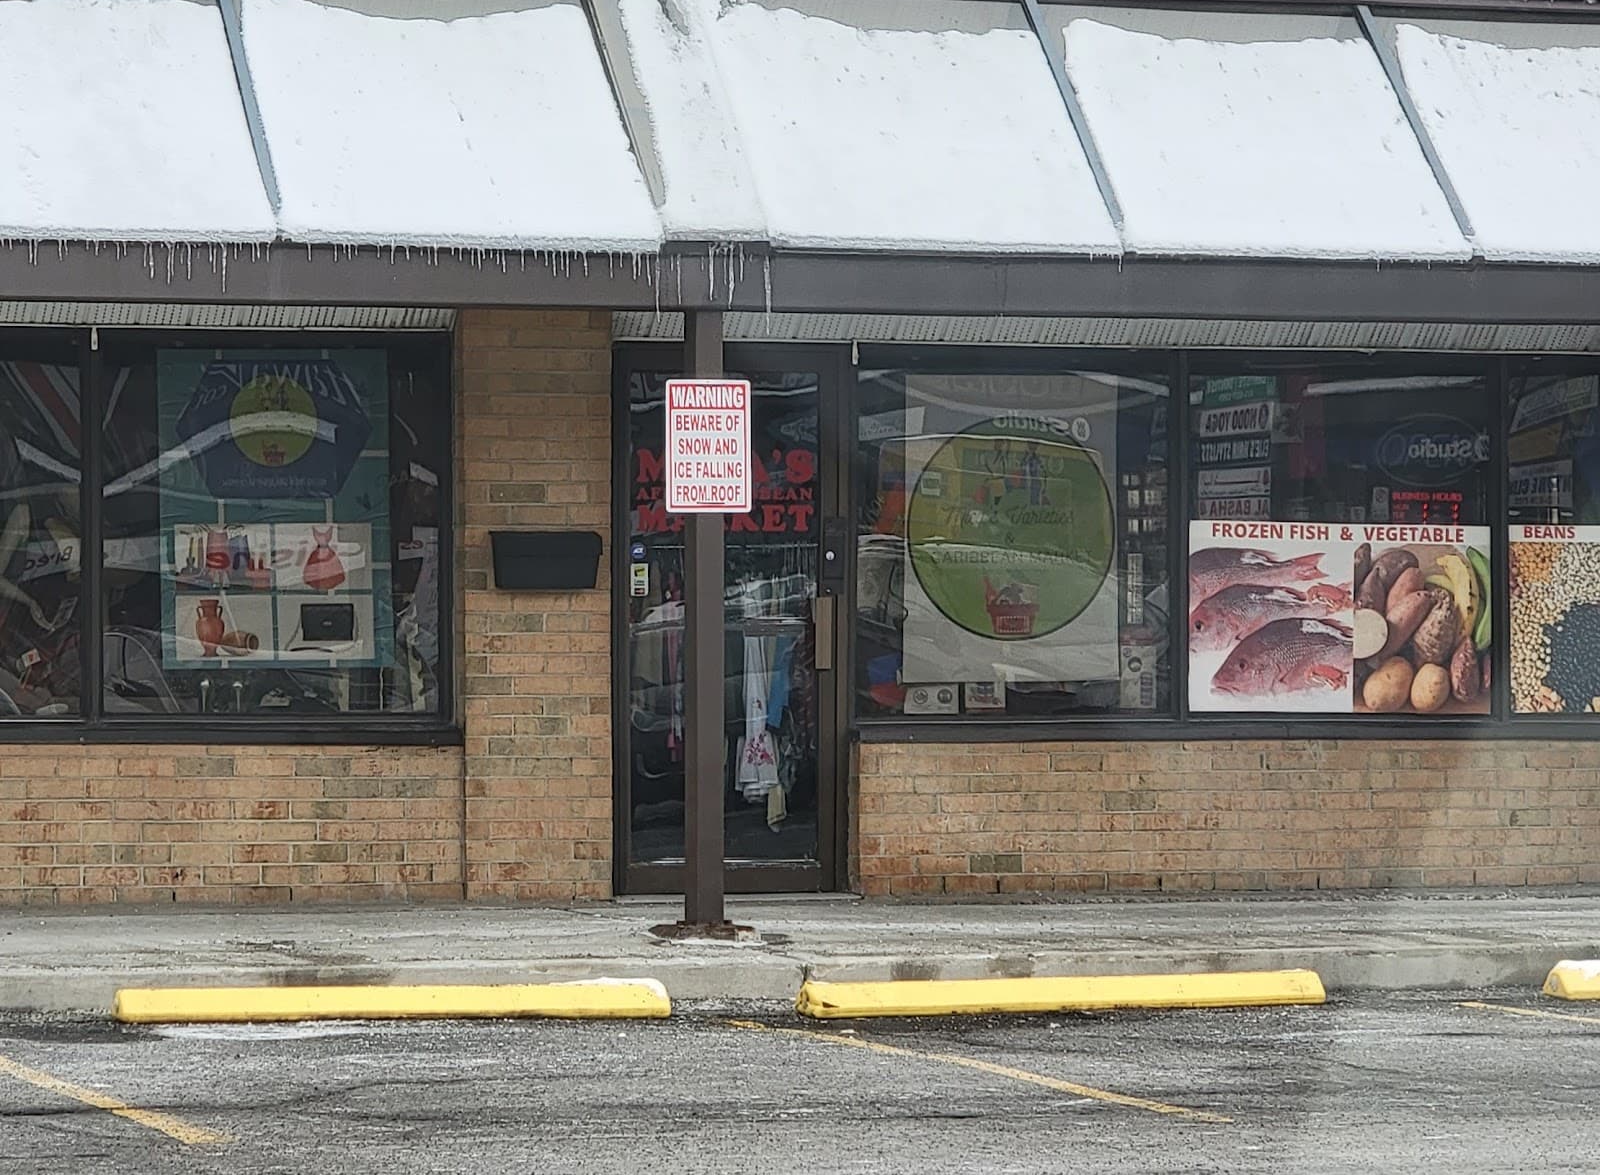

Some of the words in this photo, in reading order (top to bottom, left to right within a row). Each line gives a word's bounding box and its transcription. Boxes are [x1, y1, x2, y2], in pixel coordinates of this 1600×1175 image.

[672, 386, 744, 409] WARNING
[675, 415, 721, 431] BEWARE
[726, 415, 740, 431] OF
[678, 438, 711, 455] SNOW
[714, 438, 738, 454] AND
[674, 463, 692, 479] ICE
[696, 462, 743, 478] FALLING
[675, 485, 707, 501] FROM
[710, 485, 741, 501] ROOF
[637, 505, 814, 532] MKET
[1212, 523, 1284, 540] FROZEN
[1289, 525, 1330, 541] FISH
[1340, 526, 1354, 541] &
[1363, 526, 1466, 543] VEGETABLE
[1523, 526, 1577, 540] BEANS
